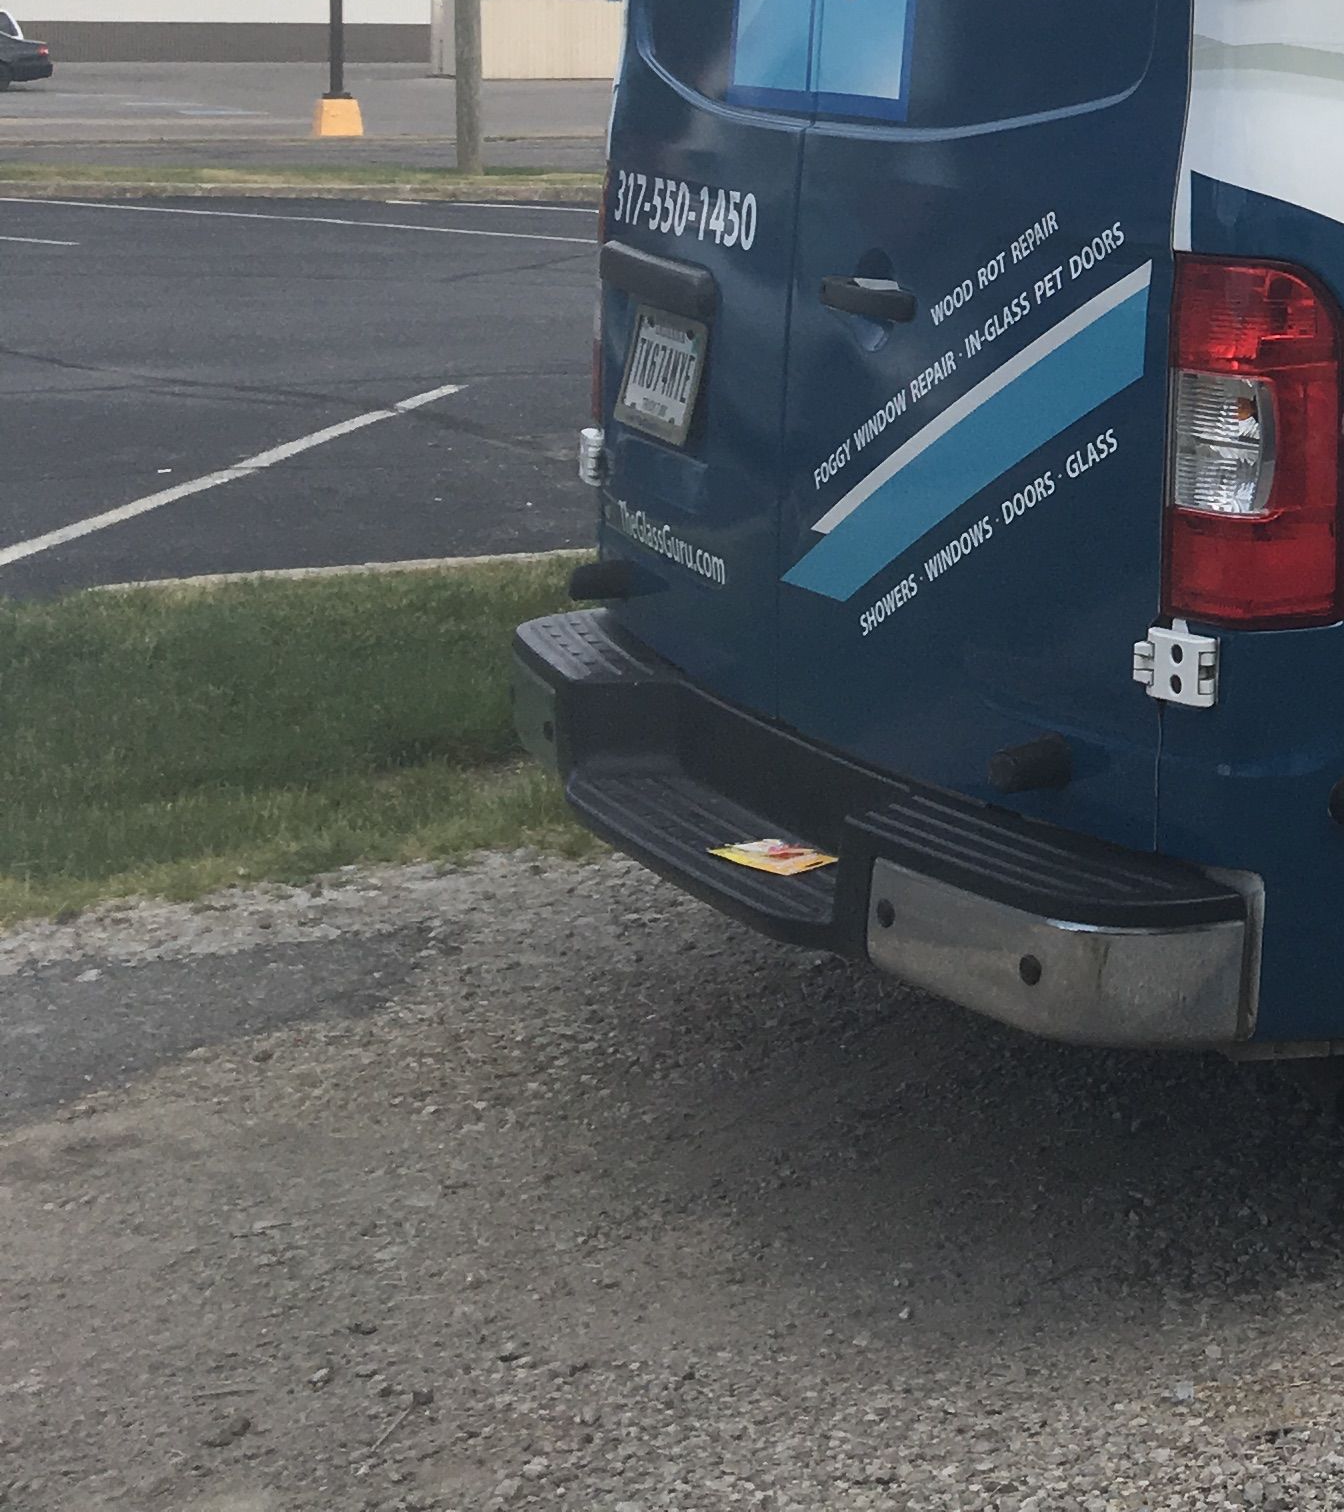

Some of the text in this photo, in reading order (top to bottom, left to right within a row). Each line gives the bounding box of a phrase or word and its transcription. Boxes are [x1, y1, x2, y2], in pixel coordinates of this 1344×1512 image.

[614, 169, 757, 251] 317-550-1450
[930, 210, 1060, 327] WOOD ROT REPAIR
[813, 221, 1126, 490] FOGGY WINDOW REPAIR IN-GLASS PET DOORS
[618, 499, 726, 585] TheGlassGuru.com
[859, 428, 1118, 637] SHOWERS WINDOWS DOORS GLASS
